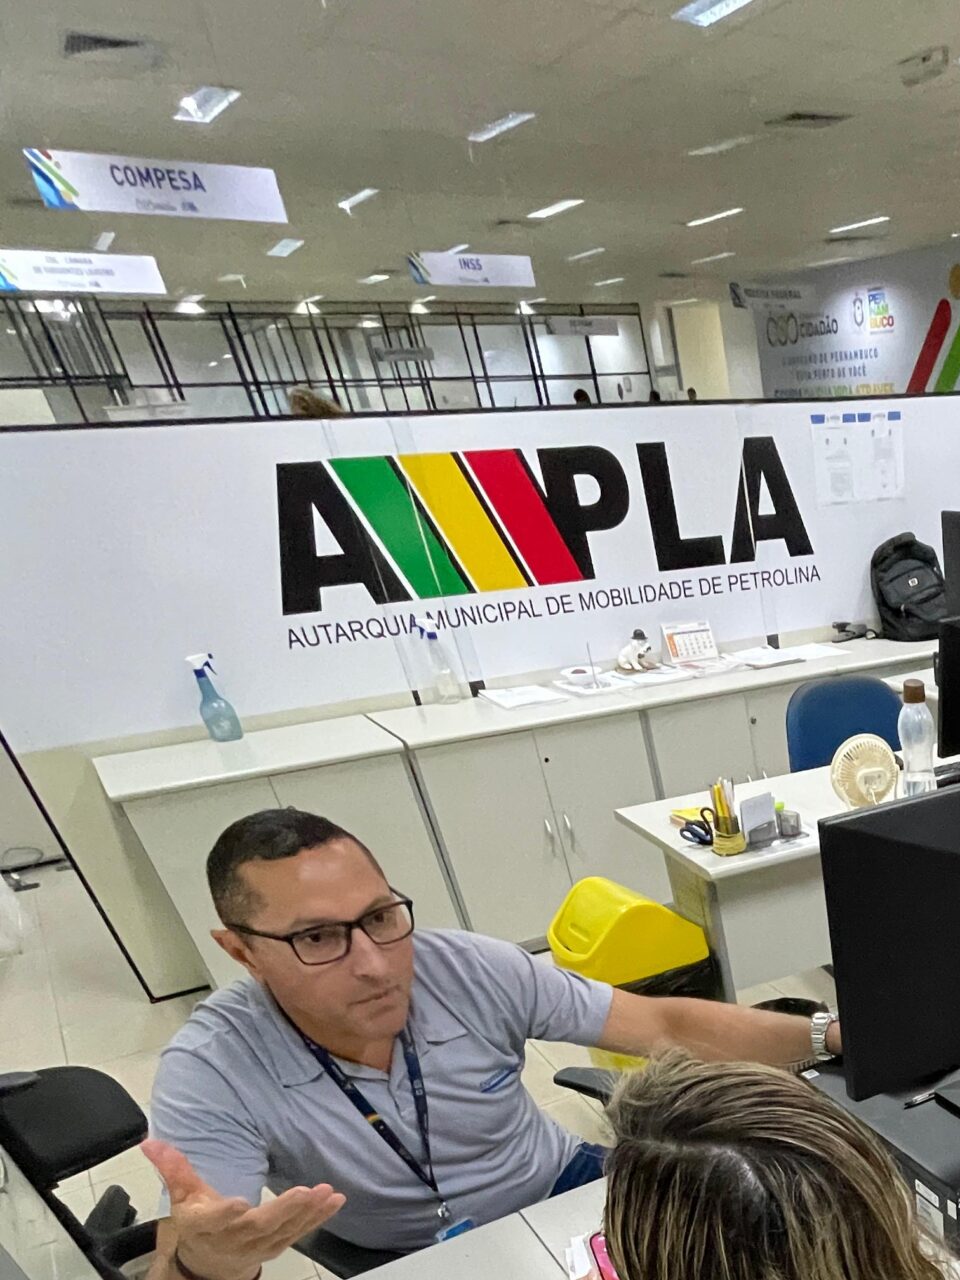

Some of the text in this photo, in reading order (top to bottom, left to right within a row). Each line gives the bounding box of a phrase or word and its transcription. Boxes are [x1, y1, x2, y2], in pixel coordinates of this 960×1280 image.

[109, 163, 207, 193] COMPESA
[458, 257, 483, 271] INSS
[288, 564, 821, 650] AUTARQUIA MUNICIPAL DE MOBILIDADE DE PETROLINA
